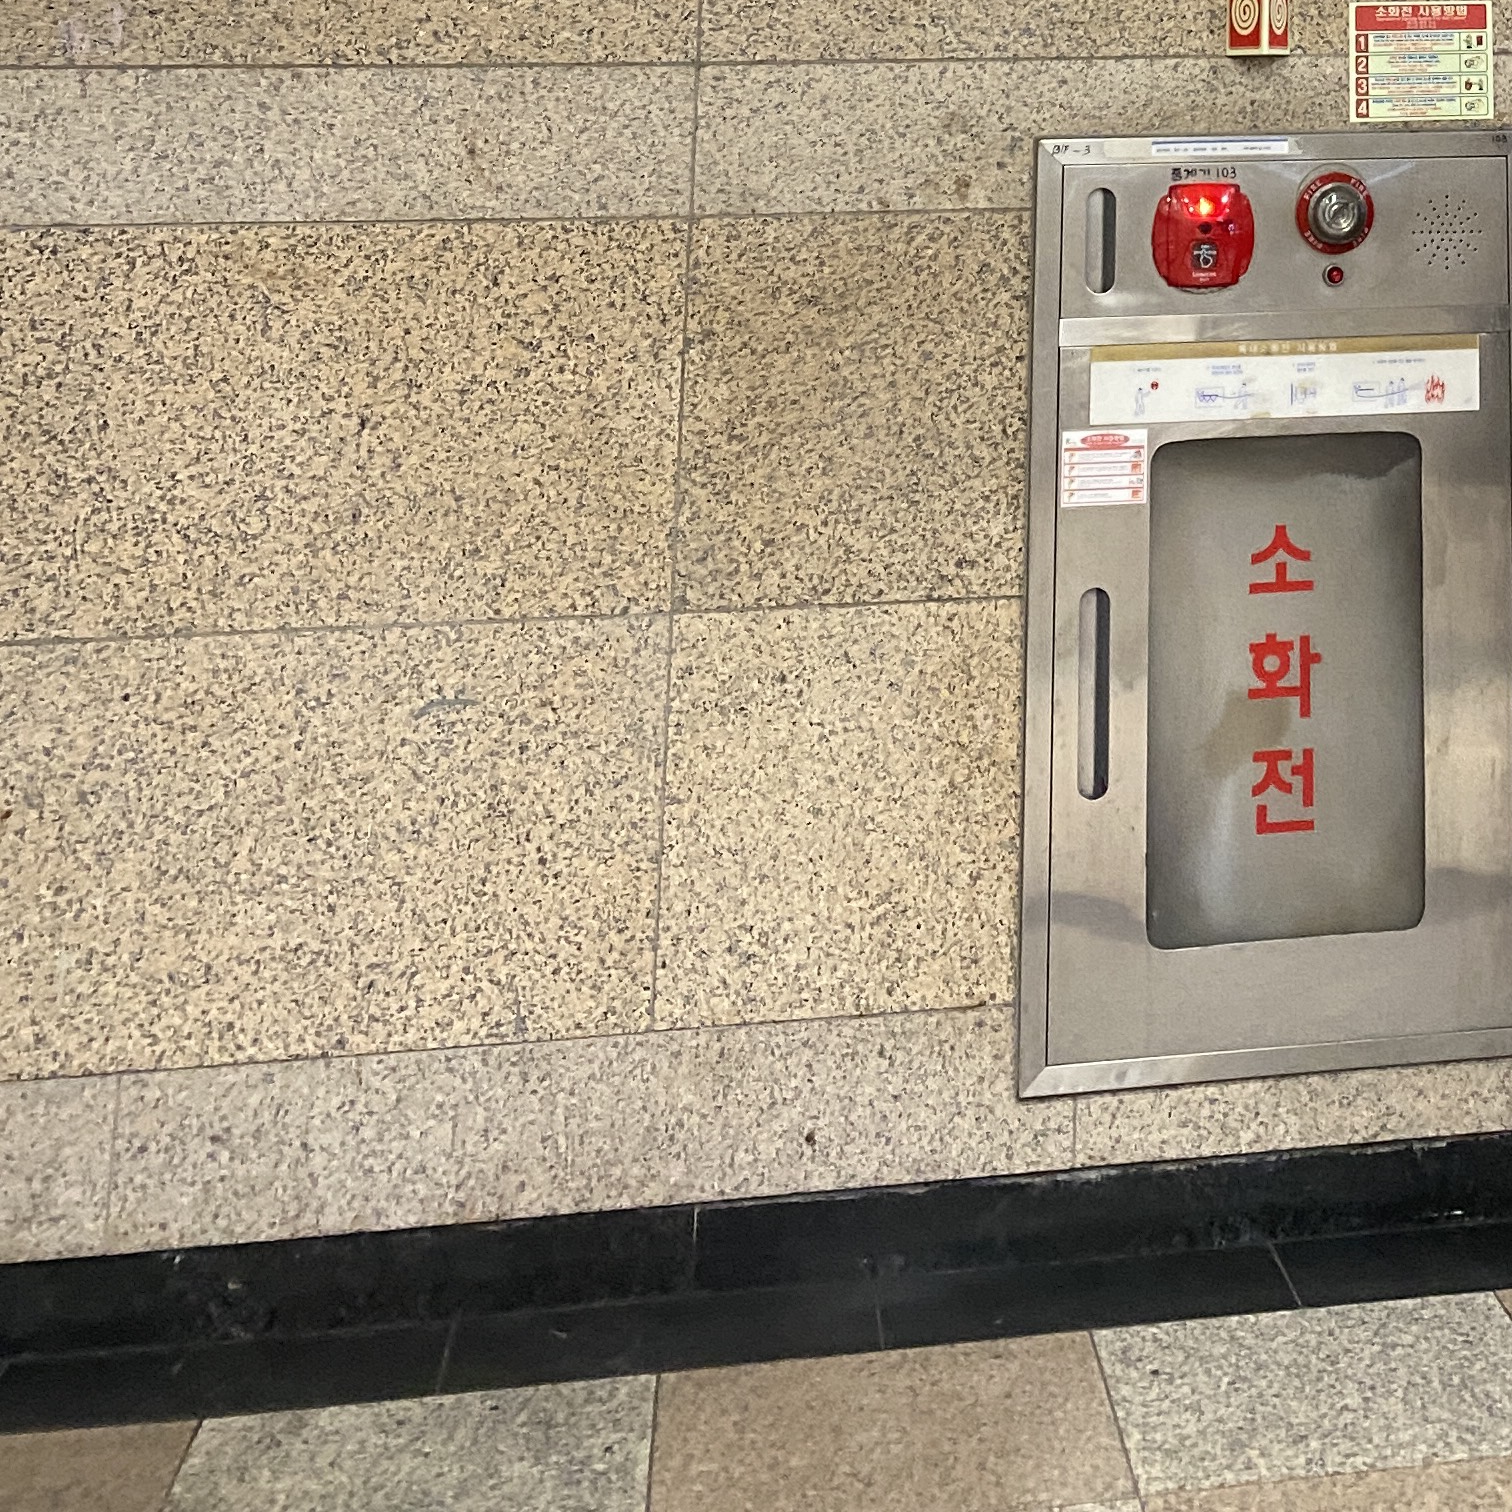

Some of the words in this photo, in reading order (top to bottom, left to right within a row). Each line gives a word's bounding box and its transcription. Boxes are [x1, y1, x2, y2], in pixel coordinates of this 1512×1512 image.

[1375, 5, 1413, 18] 소화전
[1358, 35, 1367, 52] 1
[1357, 57, 1367, 73] 2
[1357, 78, 1367, 94] 3
[1357, 100, 1367, 116] 4
[1216, 167, 1237, 179] 103
[1248, 524, 1322, 835] 소화전
